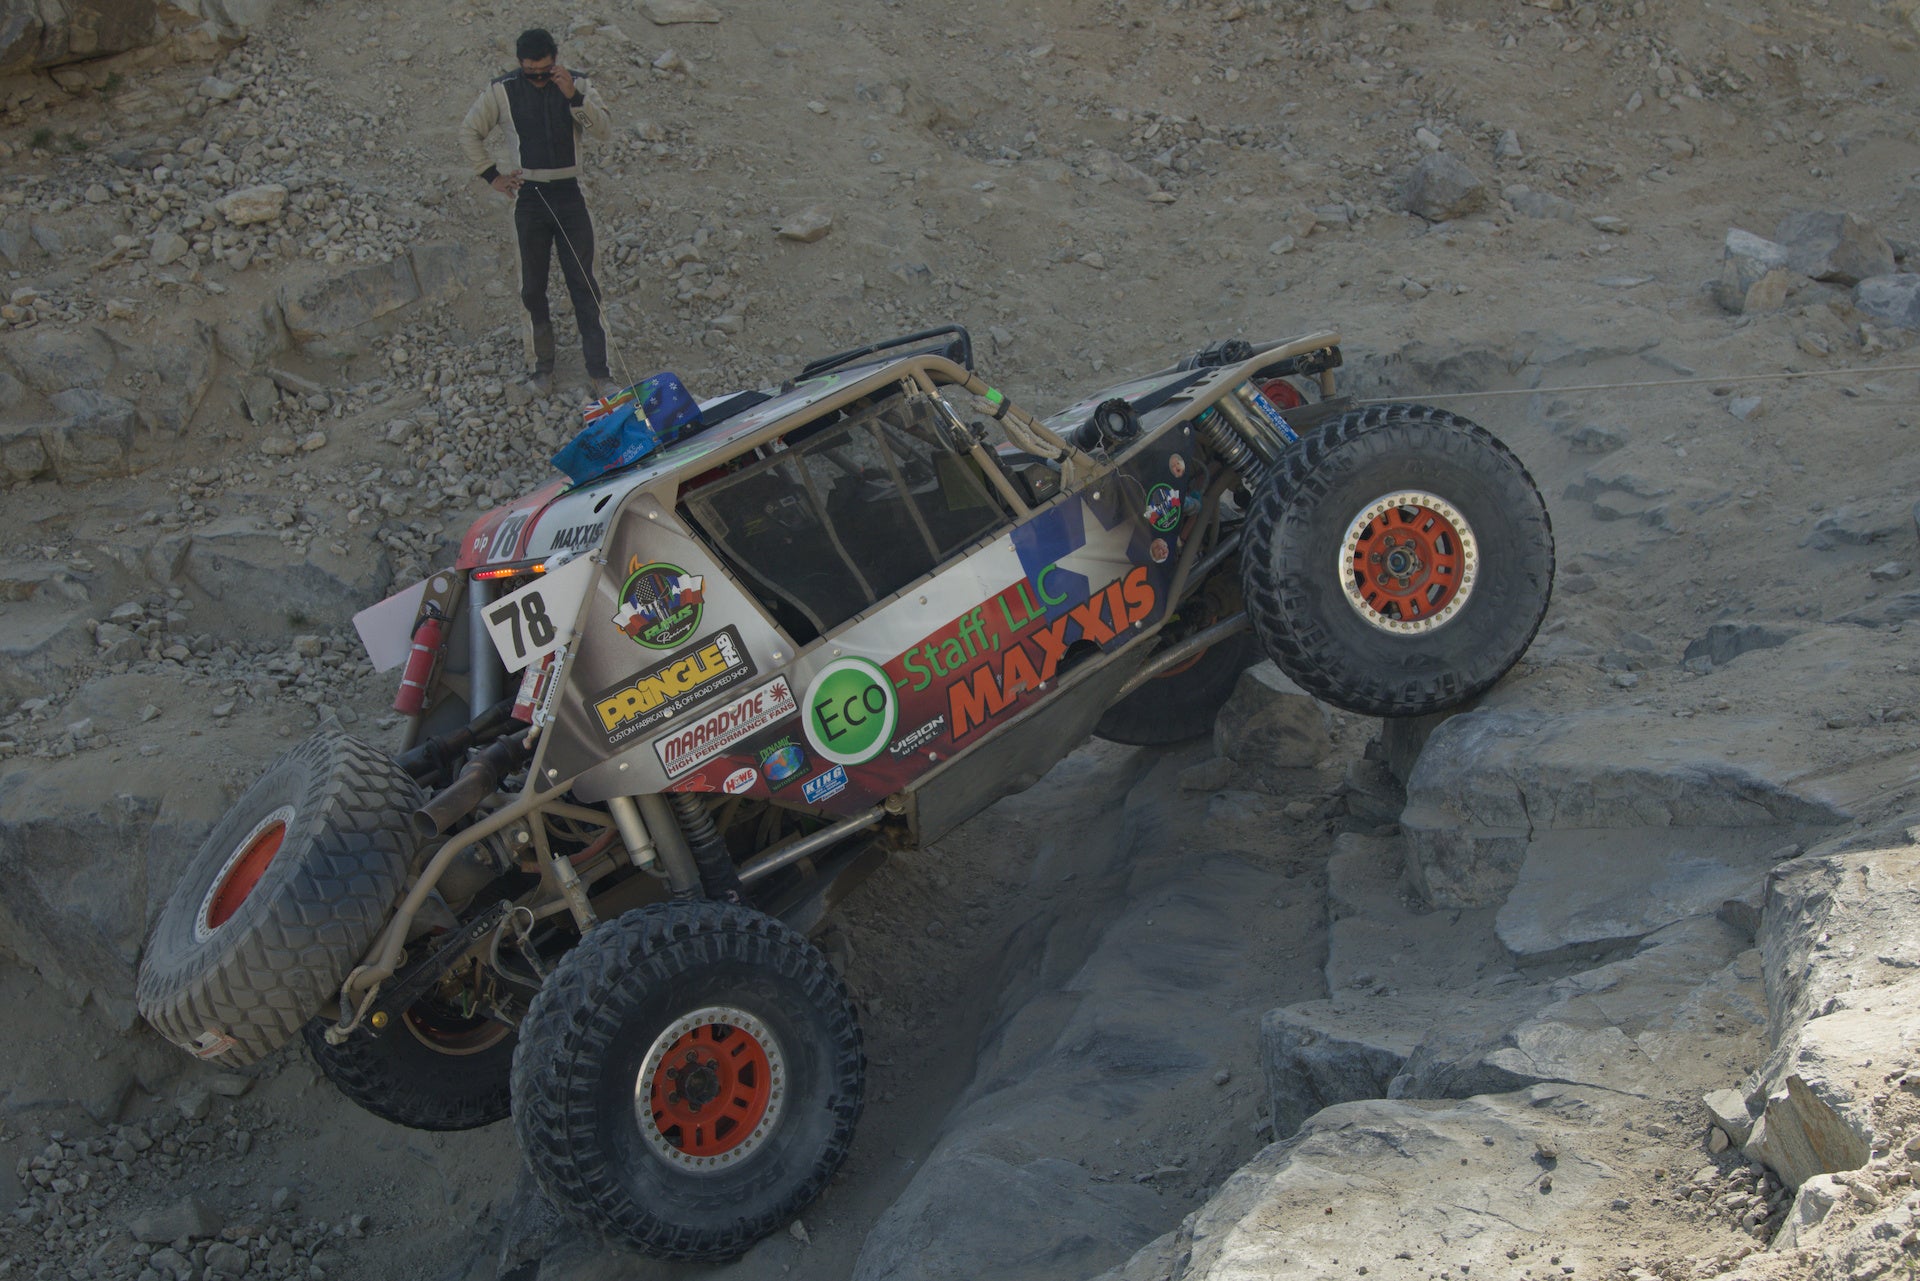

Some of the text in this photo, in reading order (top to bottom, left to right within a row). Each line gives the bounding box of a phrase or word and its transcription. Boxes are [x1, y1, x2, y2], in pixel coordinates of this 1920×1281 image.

[488, 515, 529, 560] 78
[550, 522, 604, 550] MAXXIS
[998, 564, 1068, 633] LLC
[489, 591, 556, 658] 78
[715, 632, 741, 669] FAB
[947, 565, 1156, 742] MAXXIS
[609, 666, 749, 743] CUSTOM FABRICATIN & OFF ROAD SPEED SHOP
[665, 692, 763, 763] MARADYNE
[668, 703, 795, 774] HIGH PERFORMANCE FANS
[759, 736, 791, 761] DYNAMIC
[889, 713, 945, 753] VISION
[902, 731, 938, 756] WHEEL
[805, 766, 843, 795] KING
